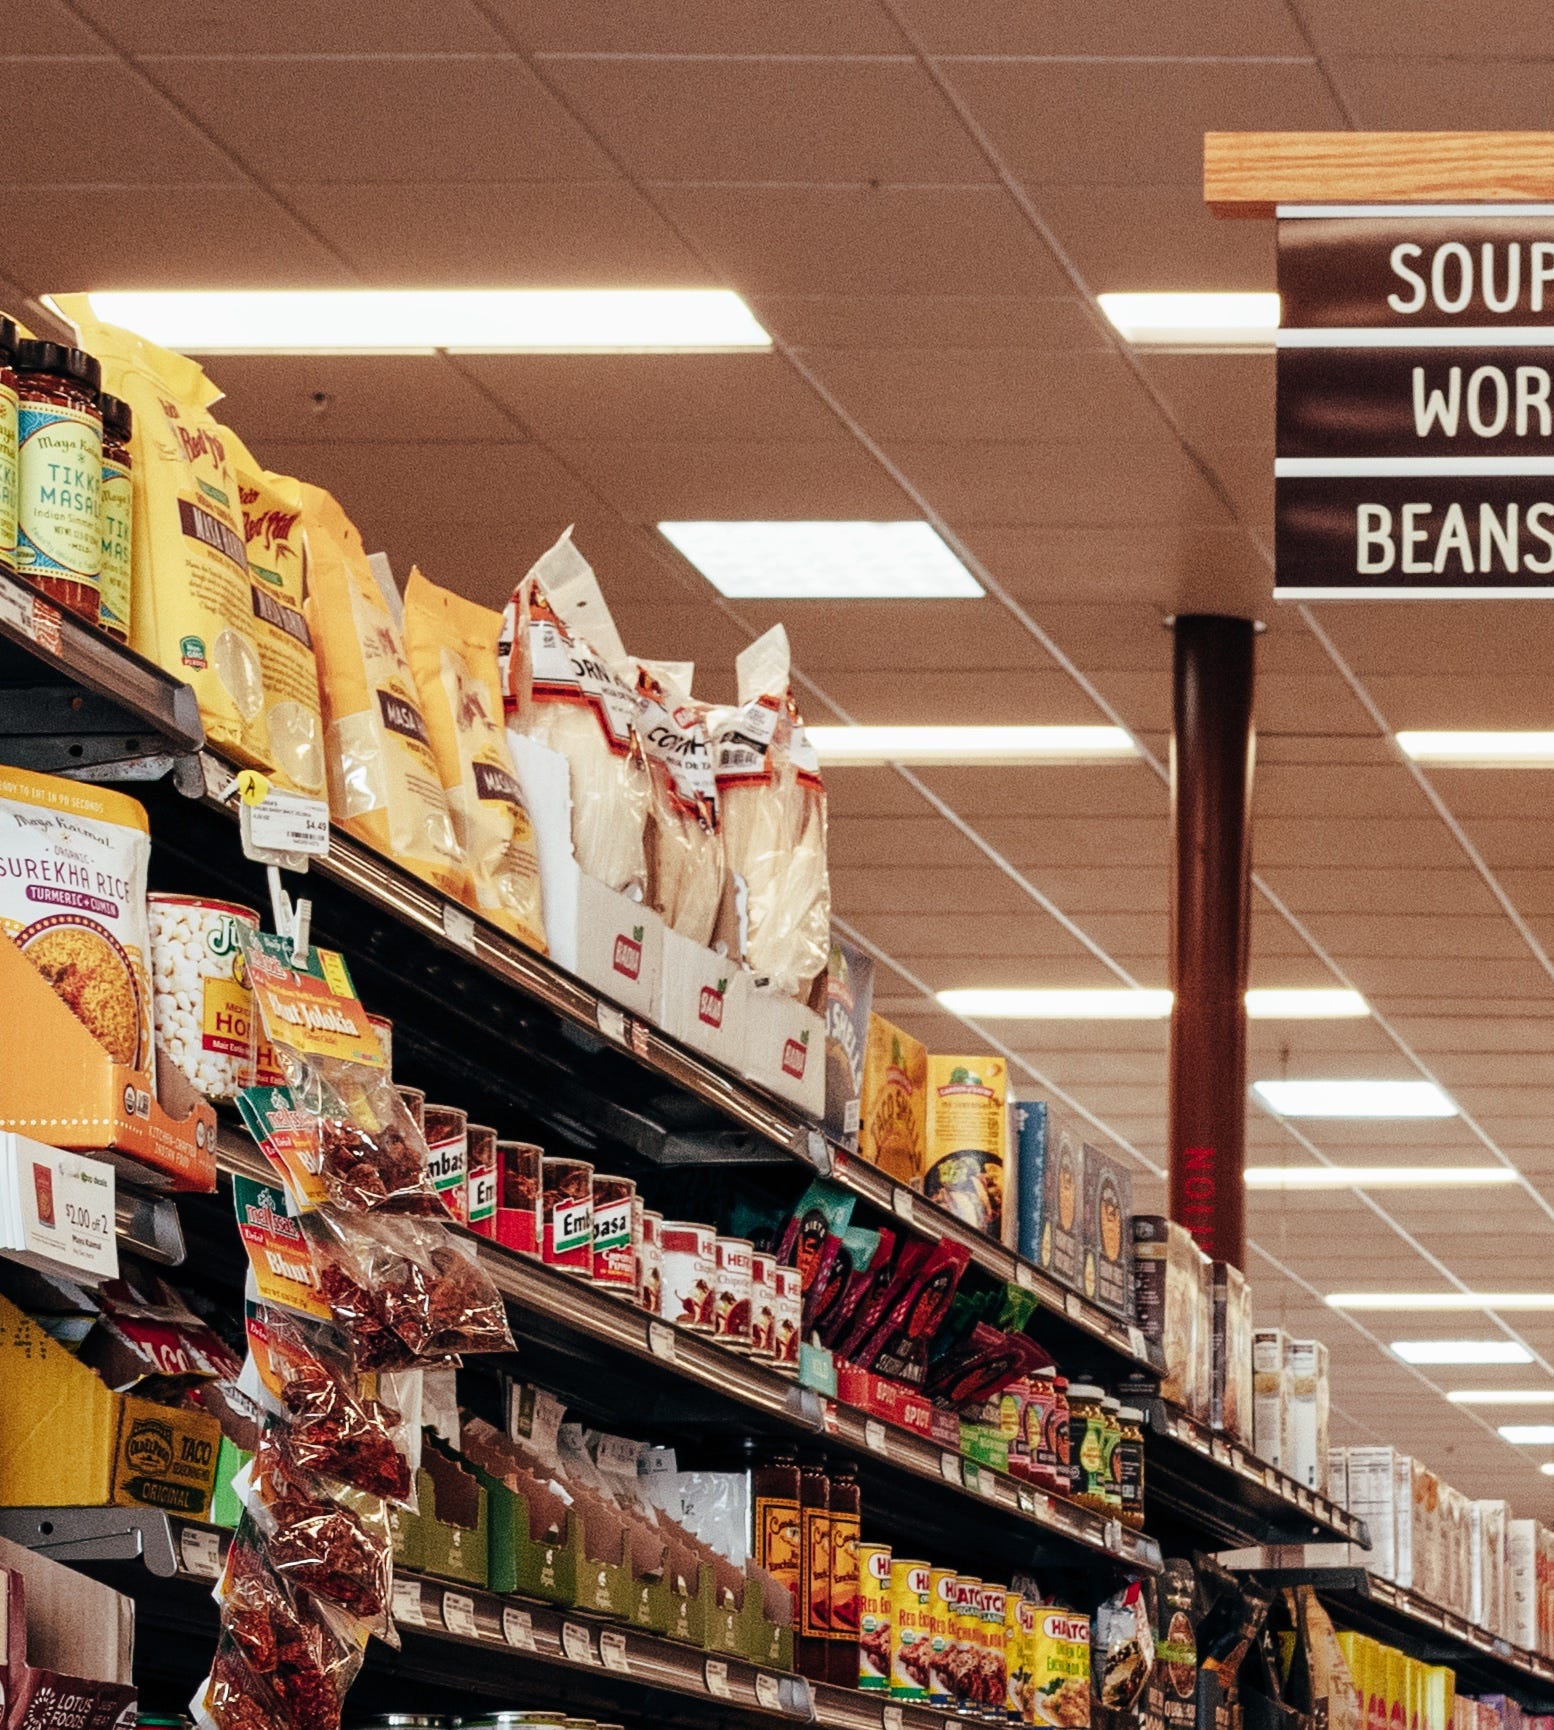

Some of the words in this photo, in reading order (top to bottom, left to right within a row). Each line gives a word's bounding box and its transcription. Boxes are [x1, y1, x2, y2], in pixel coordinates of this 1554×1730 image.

[38, 437, 77, 452] Maya
[244, 776, 256, 797] A
[14, 814, 54, 833] Maya
[55, 816, 115, 849] Kaimal
[96, 871, 131, 903] RICE
[303, 1003, 358, 1036] Jolokia
[65, 1203, 91, 1232] $2.00
[181, 1437, 214, 1467] TACO
[141, 1480, 192, 1509] ORIGINAL
[57, 1692, 94, 1714] LOTUS
[52, 1710, 87, 1730] FOODS
